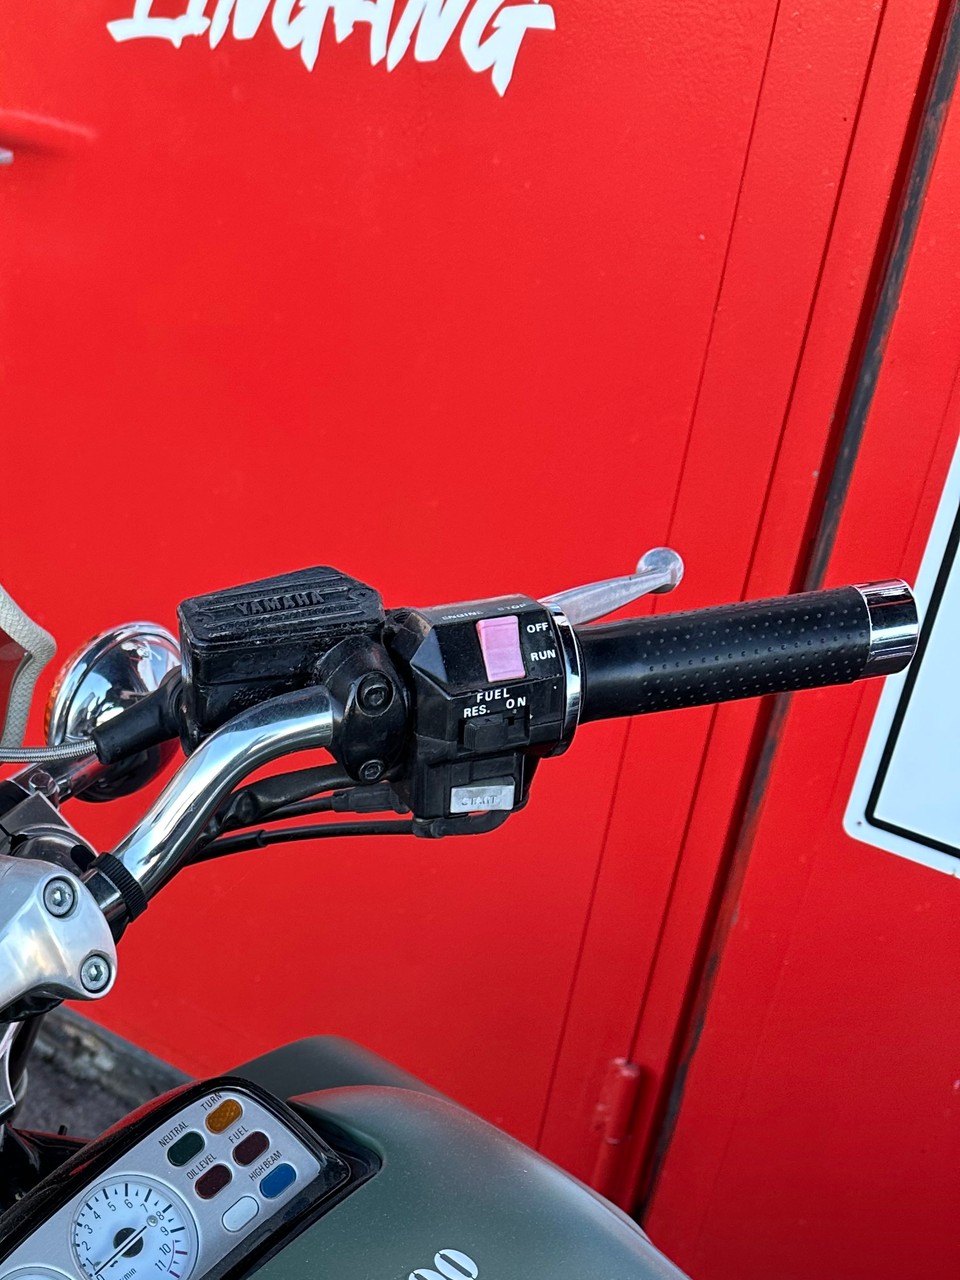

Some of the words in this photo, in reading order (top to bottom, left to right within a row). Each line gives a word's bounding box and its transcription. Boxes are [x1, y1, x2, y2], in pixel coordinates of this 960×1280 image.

[236, 590, 325, 616] YAMAHA
[526, 622, 549, 633] OFF
[530, 649, 556, 661] RUN
[476, 688, 510, 703] FUEL
[463, 704, 490, 718] RES.
[506, 696, 526, 709] ON
[201, 1092, 223, 1111] TURN
[158, 1121, 189, 1148] NEUTRAL
[228, 1125, 249, 1144] FUEL
[186, 1166, 199, 1181] OIL
[196, 1153, 217, 1173] LEVEL
[248, 1165, 265, 1182] HIGH
[262, 1150, 283, 1171] BEAM
[107, 1201, 117, 1212] 5
[124, 1198, 134, 1209] 6
[140, 1203, 148, 1213] 7
[93, 1210, 102, 1220] 4
[155, 1210, 165, 1221] 8
[83, 1224, 93, 1234] 3
[160, 1226, 170, 1236] 9
[81, 1240, 91, 1251] 2
[159, 1243, 171, 1255] 10
[154, 1259, 166, 1271] 11
